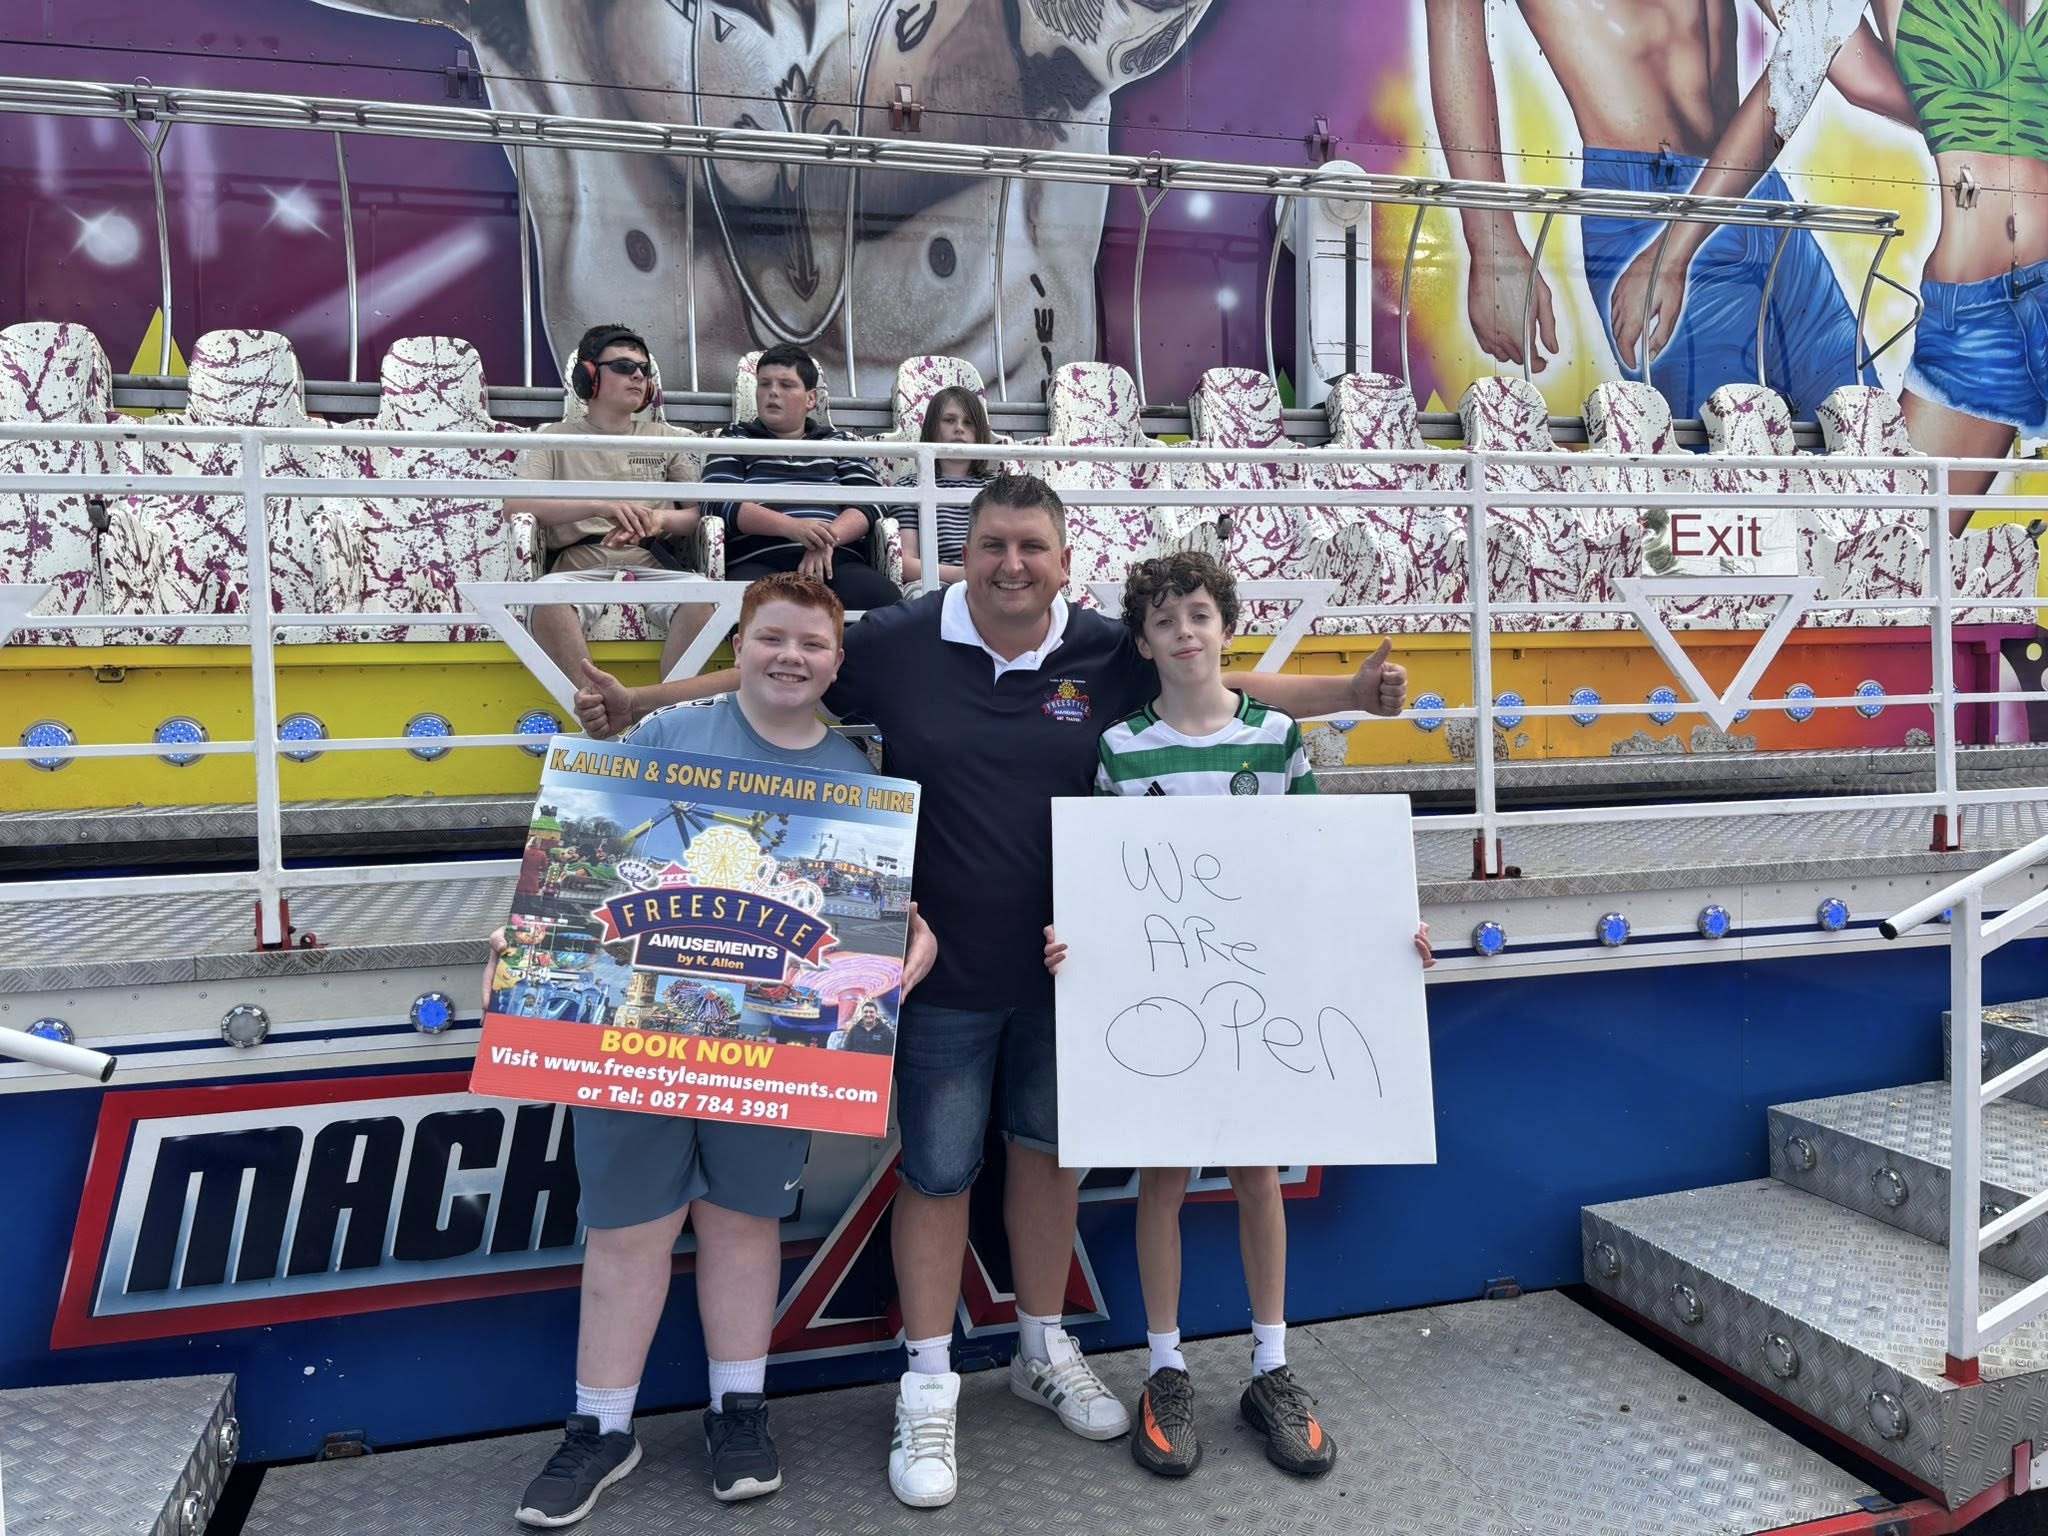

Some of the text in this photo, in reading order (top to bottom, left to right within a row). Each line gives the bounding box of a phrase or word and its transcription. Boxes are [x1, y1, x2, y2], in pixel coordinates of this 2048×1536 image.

[1671, 514, 1762, 557] Exit
[1046, 699, 1089, 712] FREESTYLE
[550, 748, 915, 814] K.ALLEN & SONS FUNFAIR FOR HIRE
[1121, 841, 1241, 903] We
[622, 894, 813, 948] FREESTYLE
[648, 933, 779, 960] AMUSEMENTS
[677, 953, 744, 970] by K. Allen
[600, 1029, 774, 1069] BOOK NOW
[491, 1045, 878, 1103] Visit www.freestyleamusements.com
[577, 1085, 789, 1120] or Tel: 087 784 3981
[125, 1102, 583, 1294] MACH
